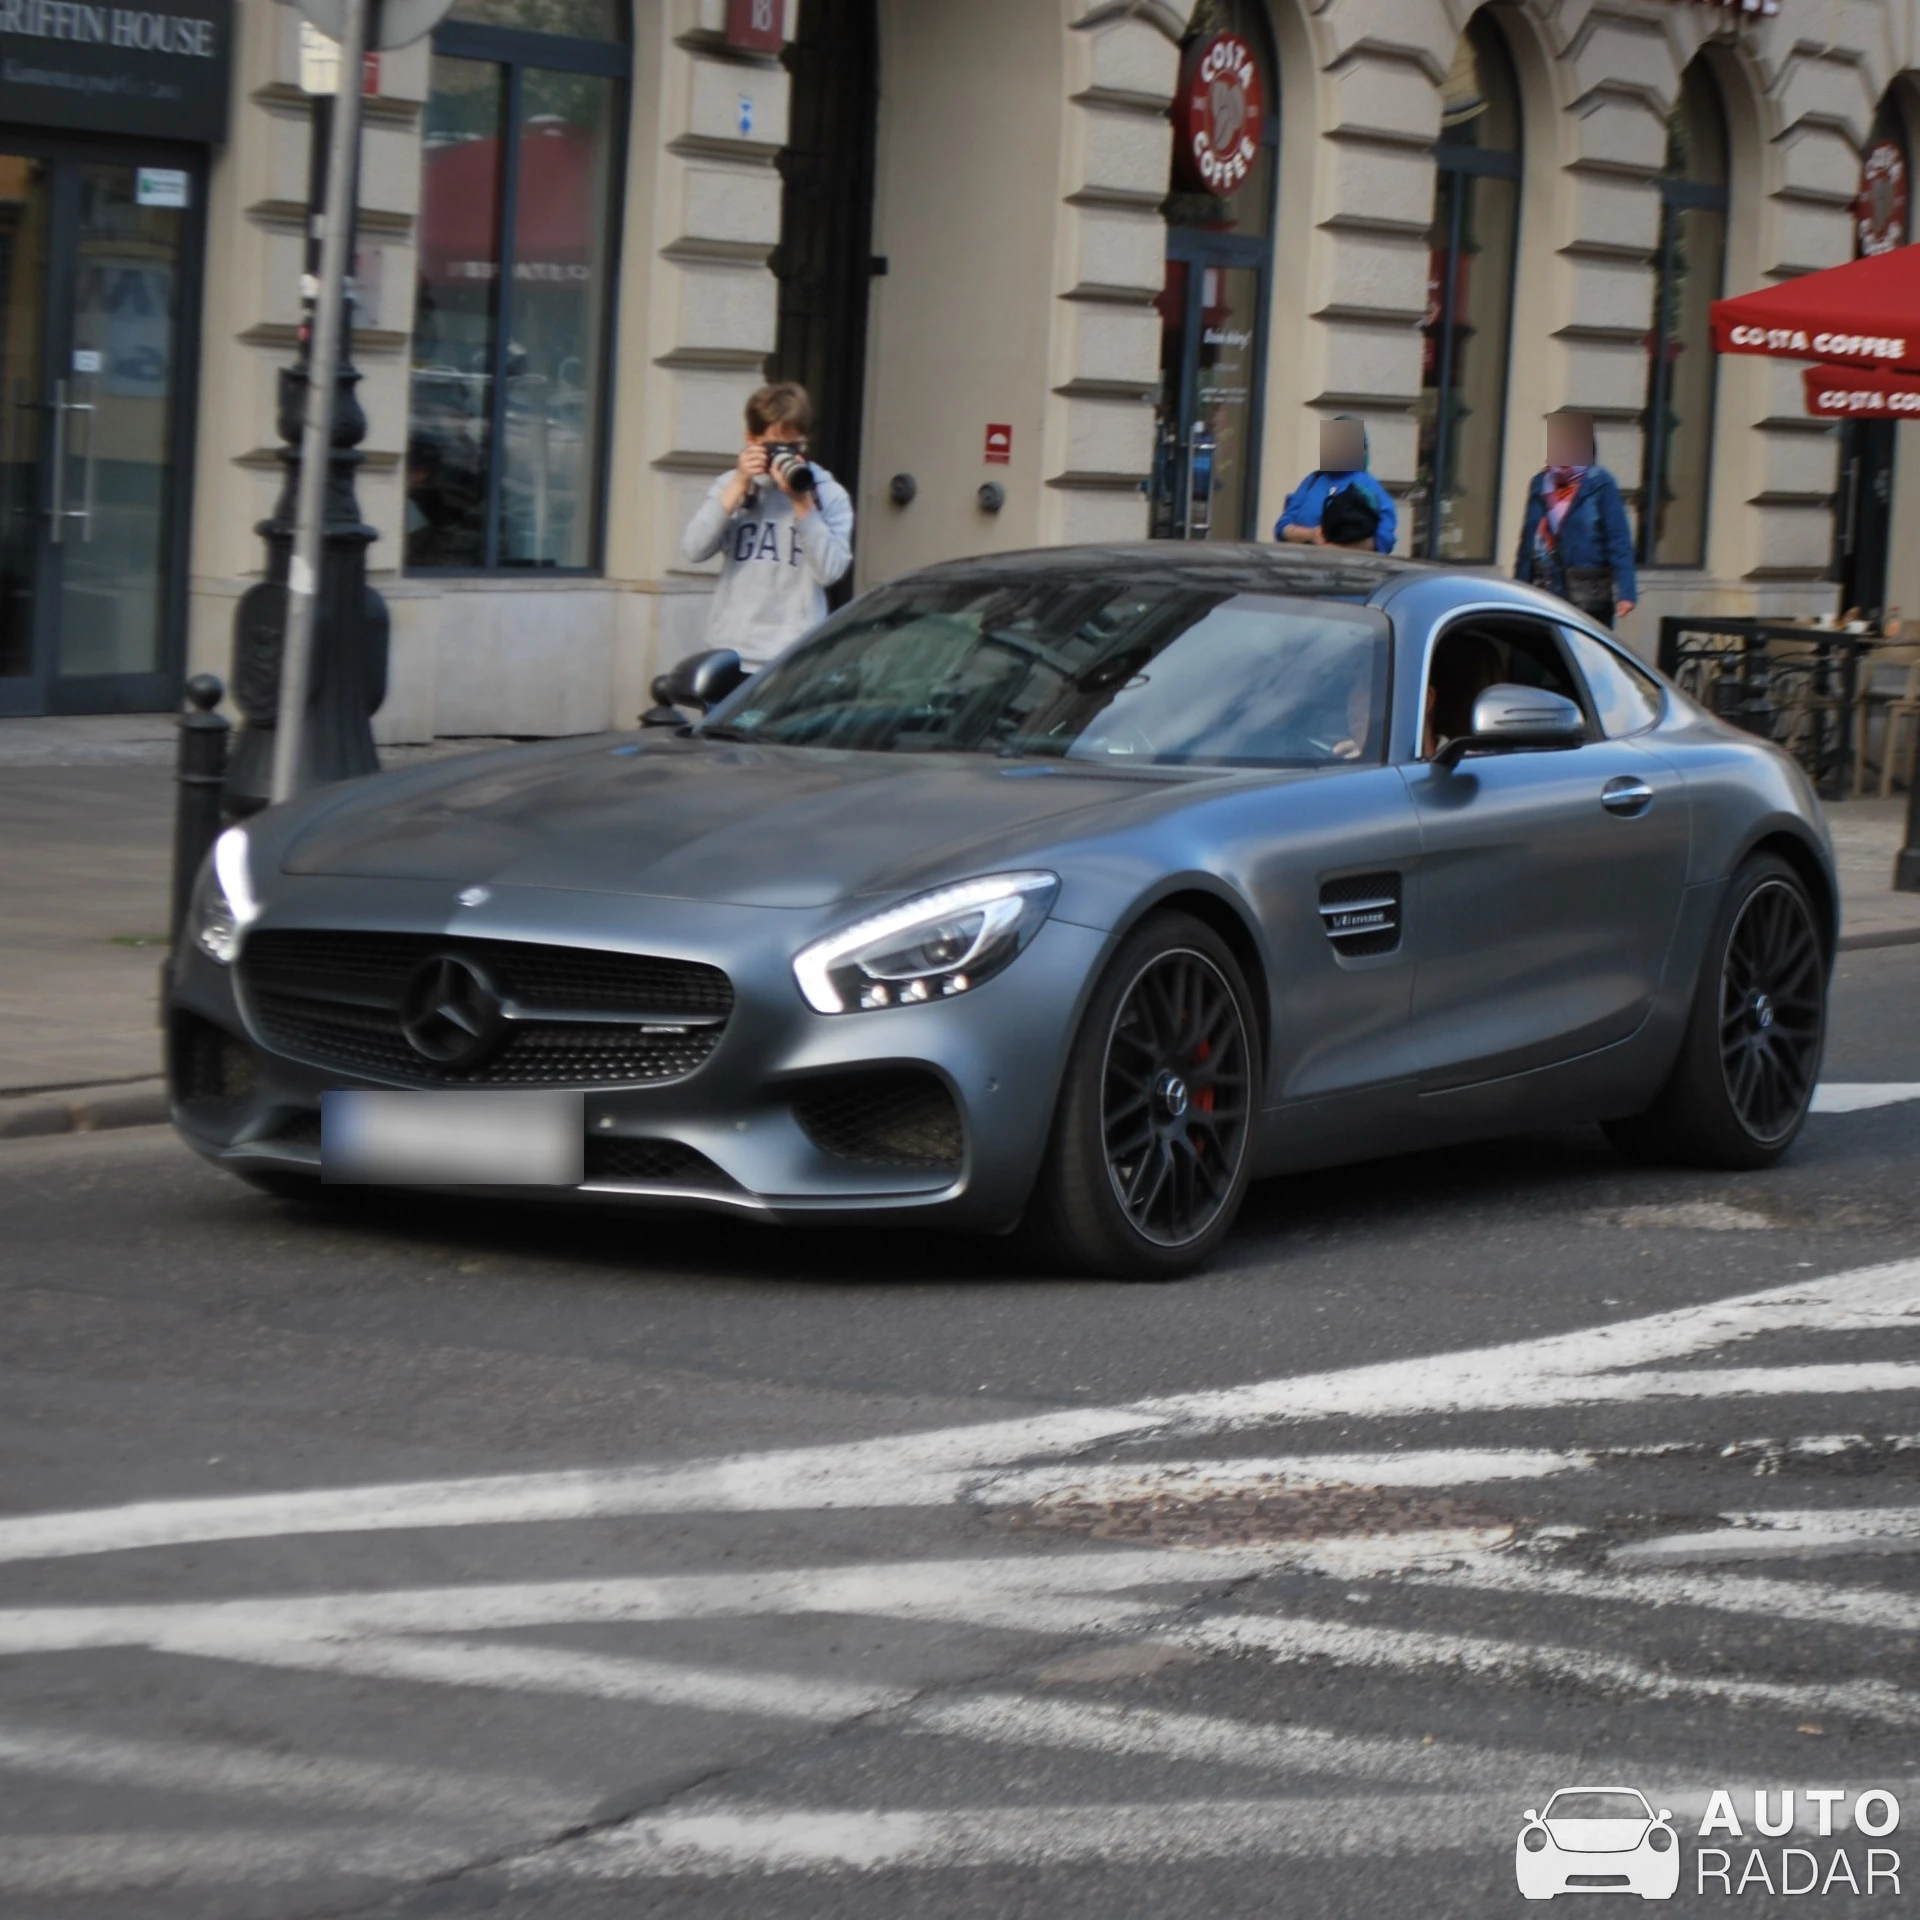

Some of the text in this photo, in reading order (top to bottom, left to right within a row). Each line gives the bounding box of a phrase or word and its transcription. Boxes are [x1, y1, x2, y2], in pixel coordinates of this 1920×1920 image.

[0, 0, 214, 57] RIFFIN HOUSE
[1201, 40, 1254, 89] COSTA
[1193, 130, 1256, 188] COFFEE
[1730, 325, 1905, 359] COSTA COFFEE
[1818, 390, 1920, 412] COSTA CO
